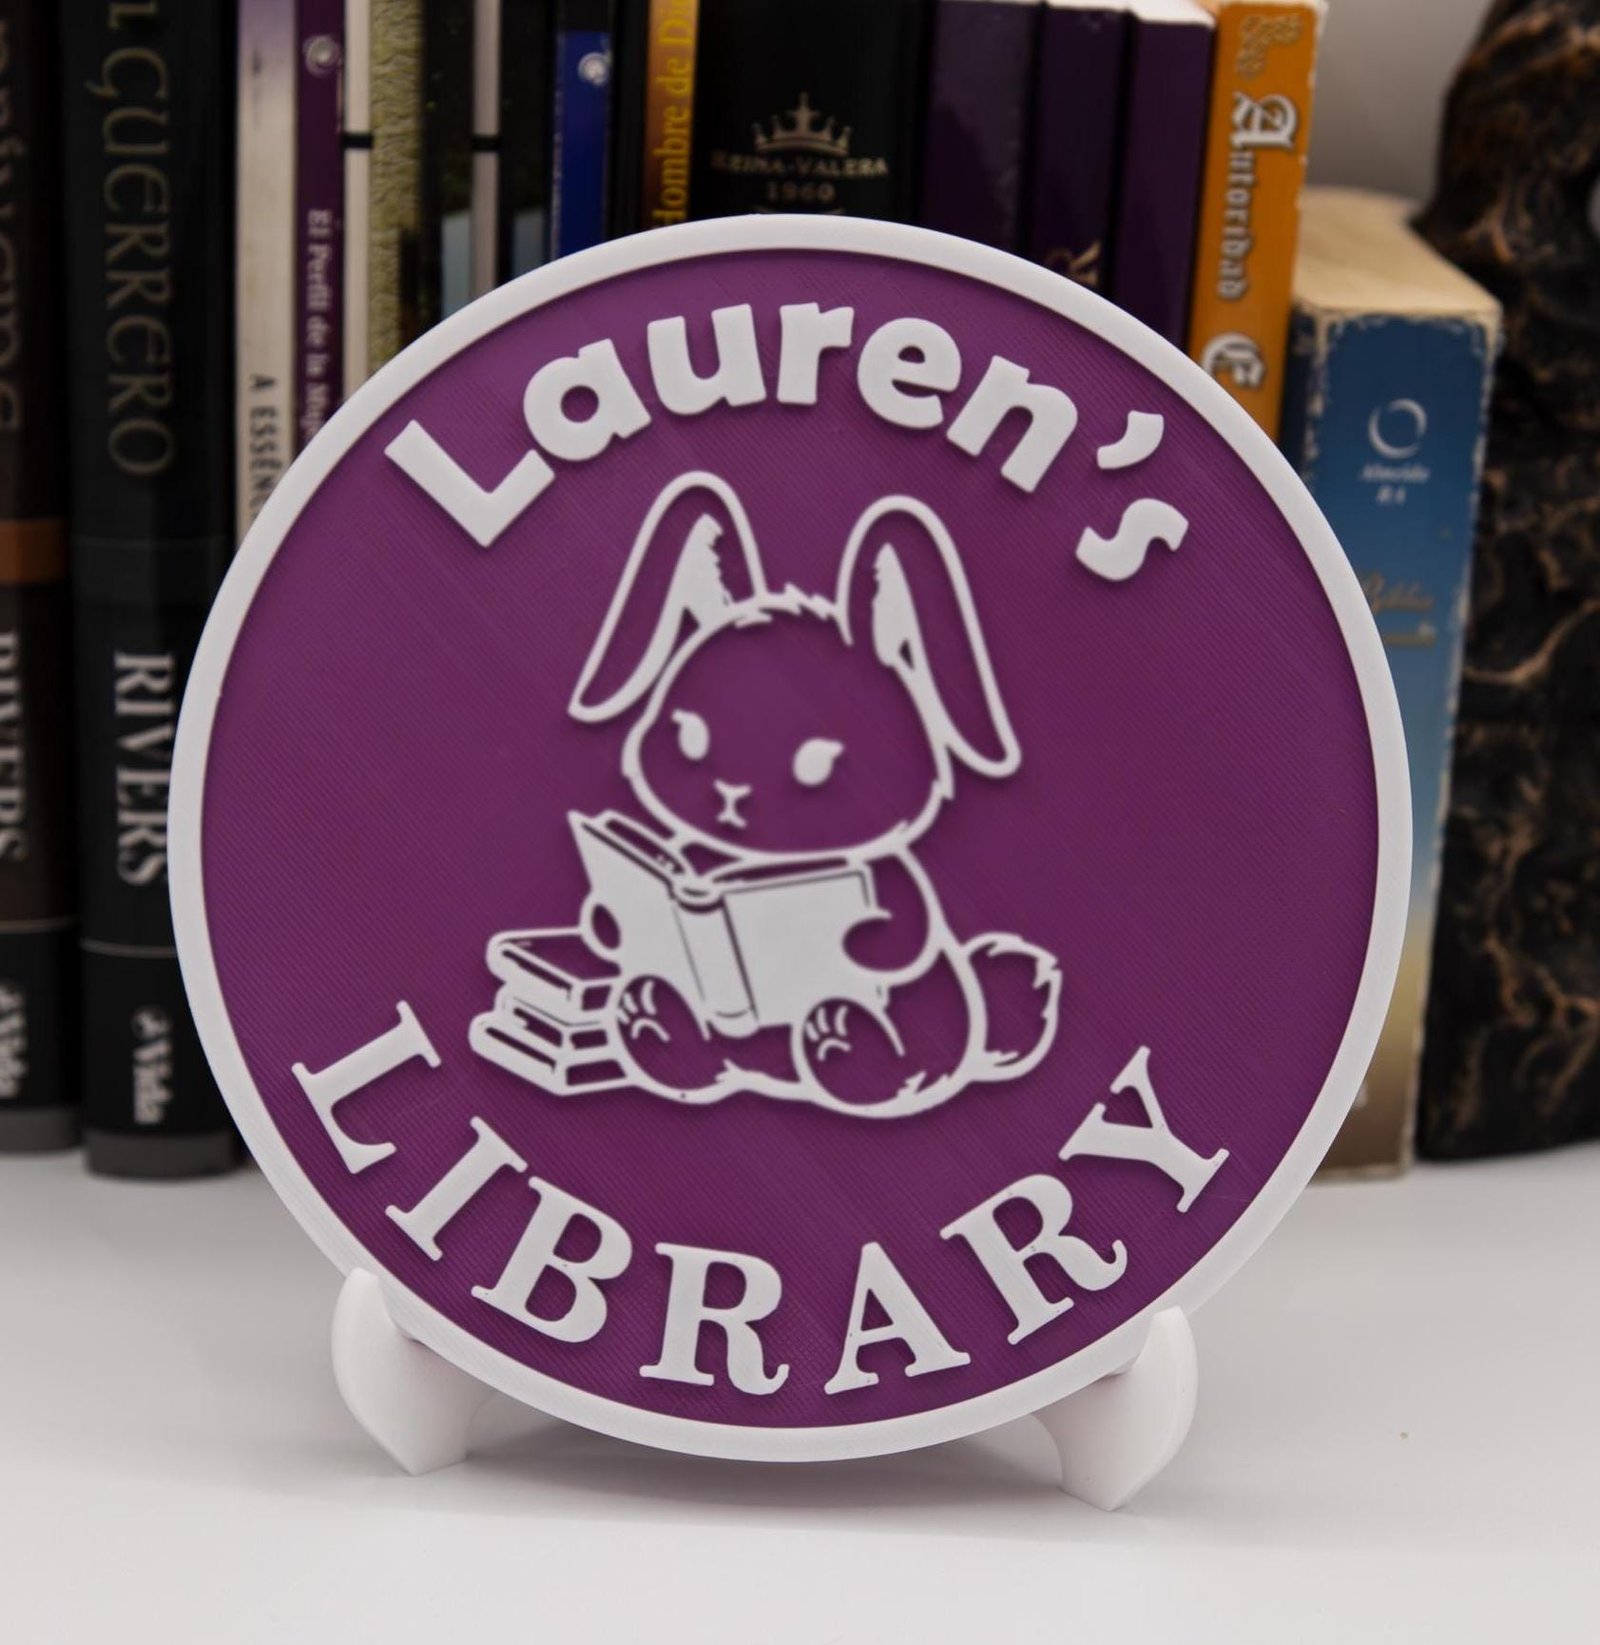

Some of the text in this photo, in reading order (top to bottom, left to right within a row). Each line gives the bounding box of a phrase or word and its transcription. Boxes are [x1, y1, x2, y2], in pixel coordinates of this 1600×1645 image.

[656, 57, 692, 98] de
[658, 0, 695, 47] Di
[1217, 92, 1298, 300] Autoridad
[85, 46, 176, 477] GUERRERO
[304, 353, 331, 377] la
[305, 315, 332, 347] de
[114, 651, 176, 886] RIVERS
[291, 1001, 1229, 1395] LIBRARY
